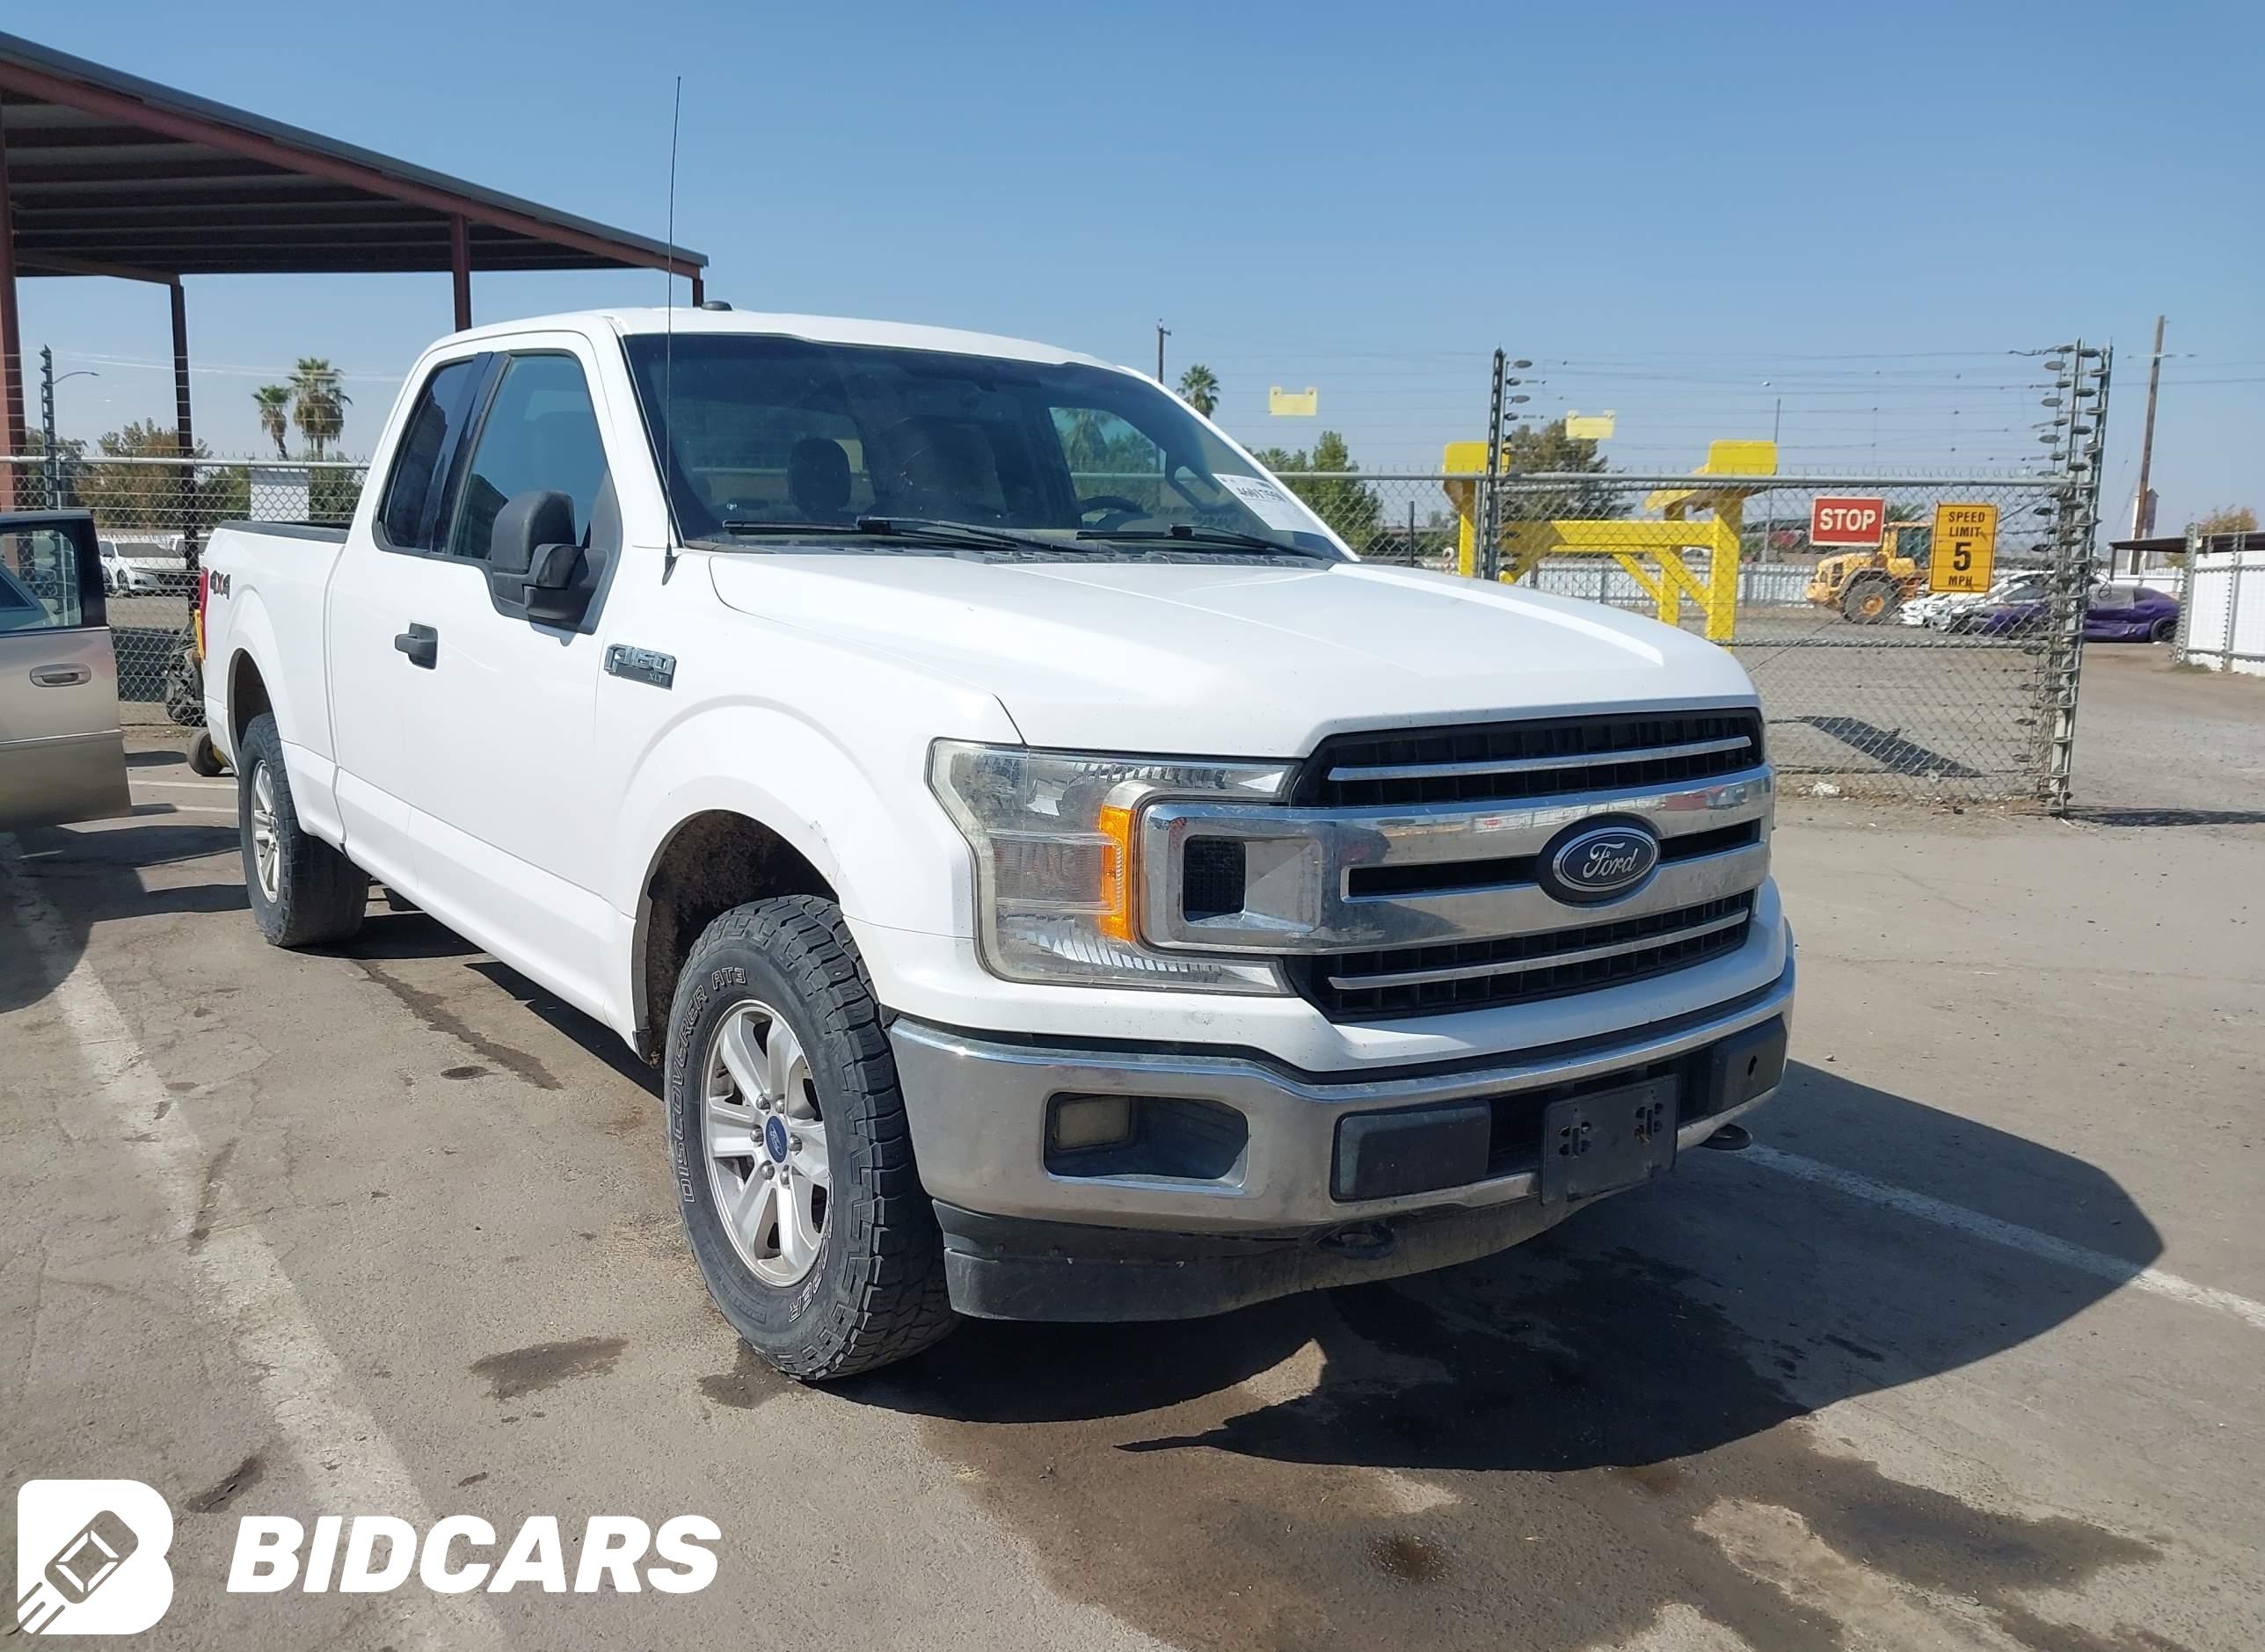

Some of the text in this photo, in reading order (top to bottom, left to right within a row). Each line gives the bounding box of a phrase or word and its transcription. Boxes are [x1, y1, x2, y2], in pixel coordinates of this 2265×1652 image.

[1819, 508, 1876, 532] STOP
[1948, 512, 1985, 523] SPEED
[1949, 527, 1981, 538] LIMIT
[1954, 542, 1972, 571] 5
[1948, 576, 1973, 587] MPH
[1583, 841, 1639, 878] Ford
[671, 966, 747, 1203] DISCOVERER AT3
